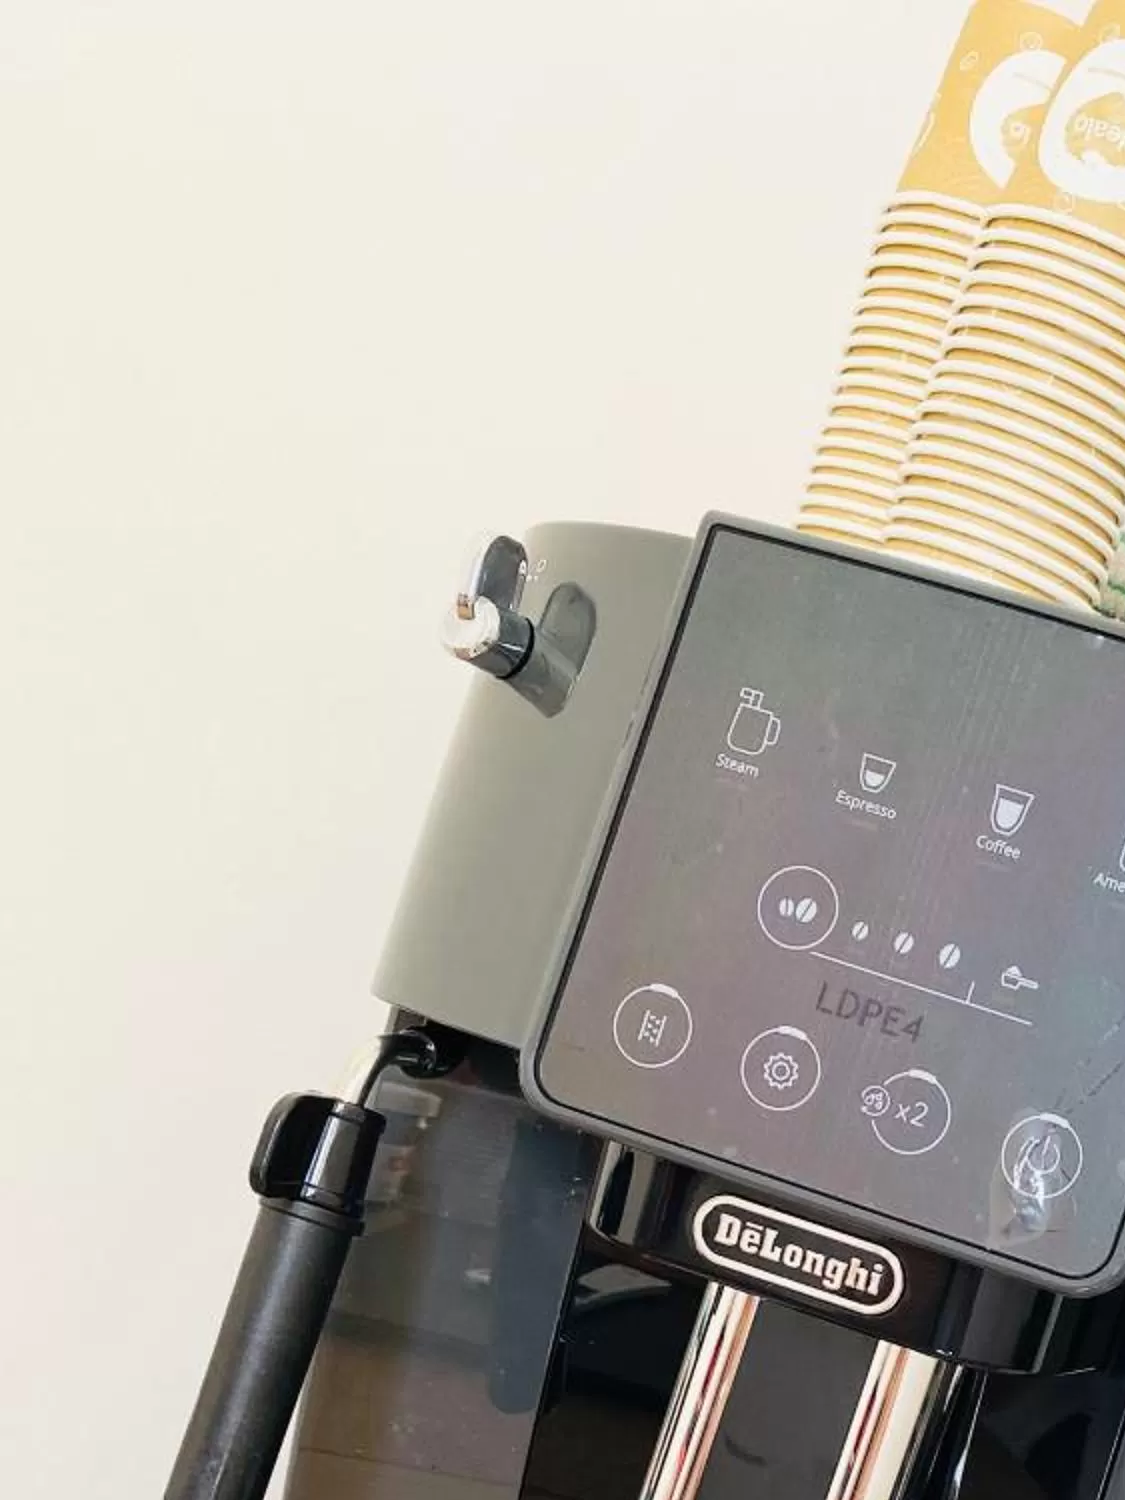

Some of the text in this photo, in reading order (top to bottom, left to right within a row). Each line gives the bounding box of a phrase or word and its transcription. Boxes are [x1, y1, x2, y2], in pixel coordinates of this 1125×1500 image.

[715, 753, 760, 778] Steam
[835, 789, 897, 819] Espresso
[975, 834, 1021, 860] Coffee
[815, 980, 925, 1043] LDPE4
